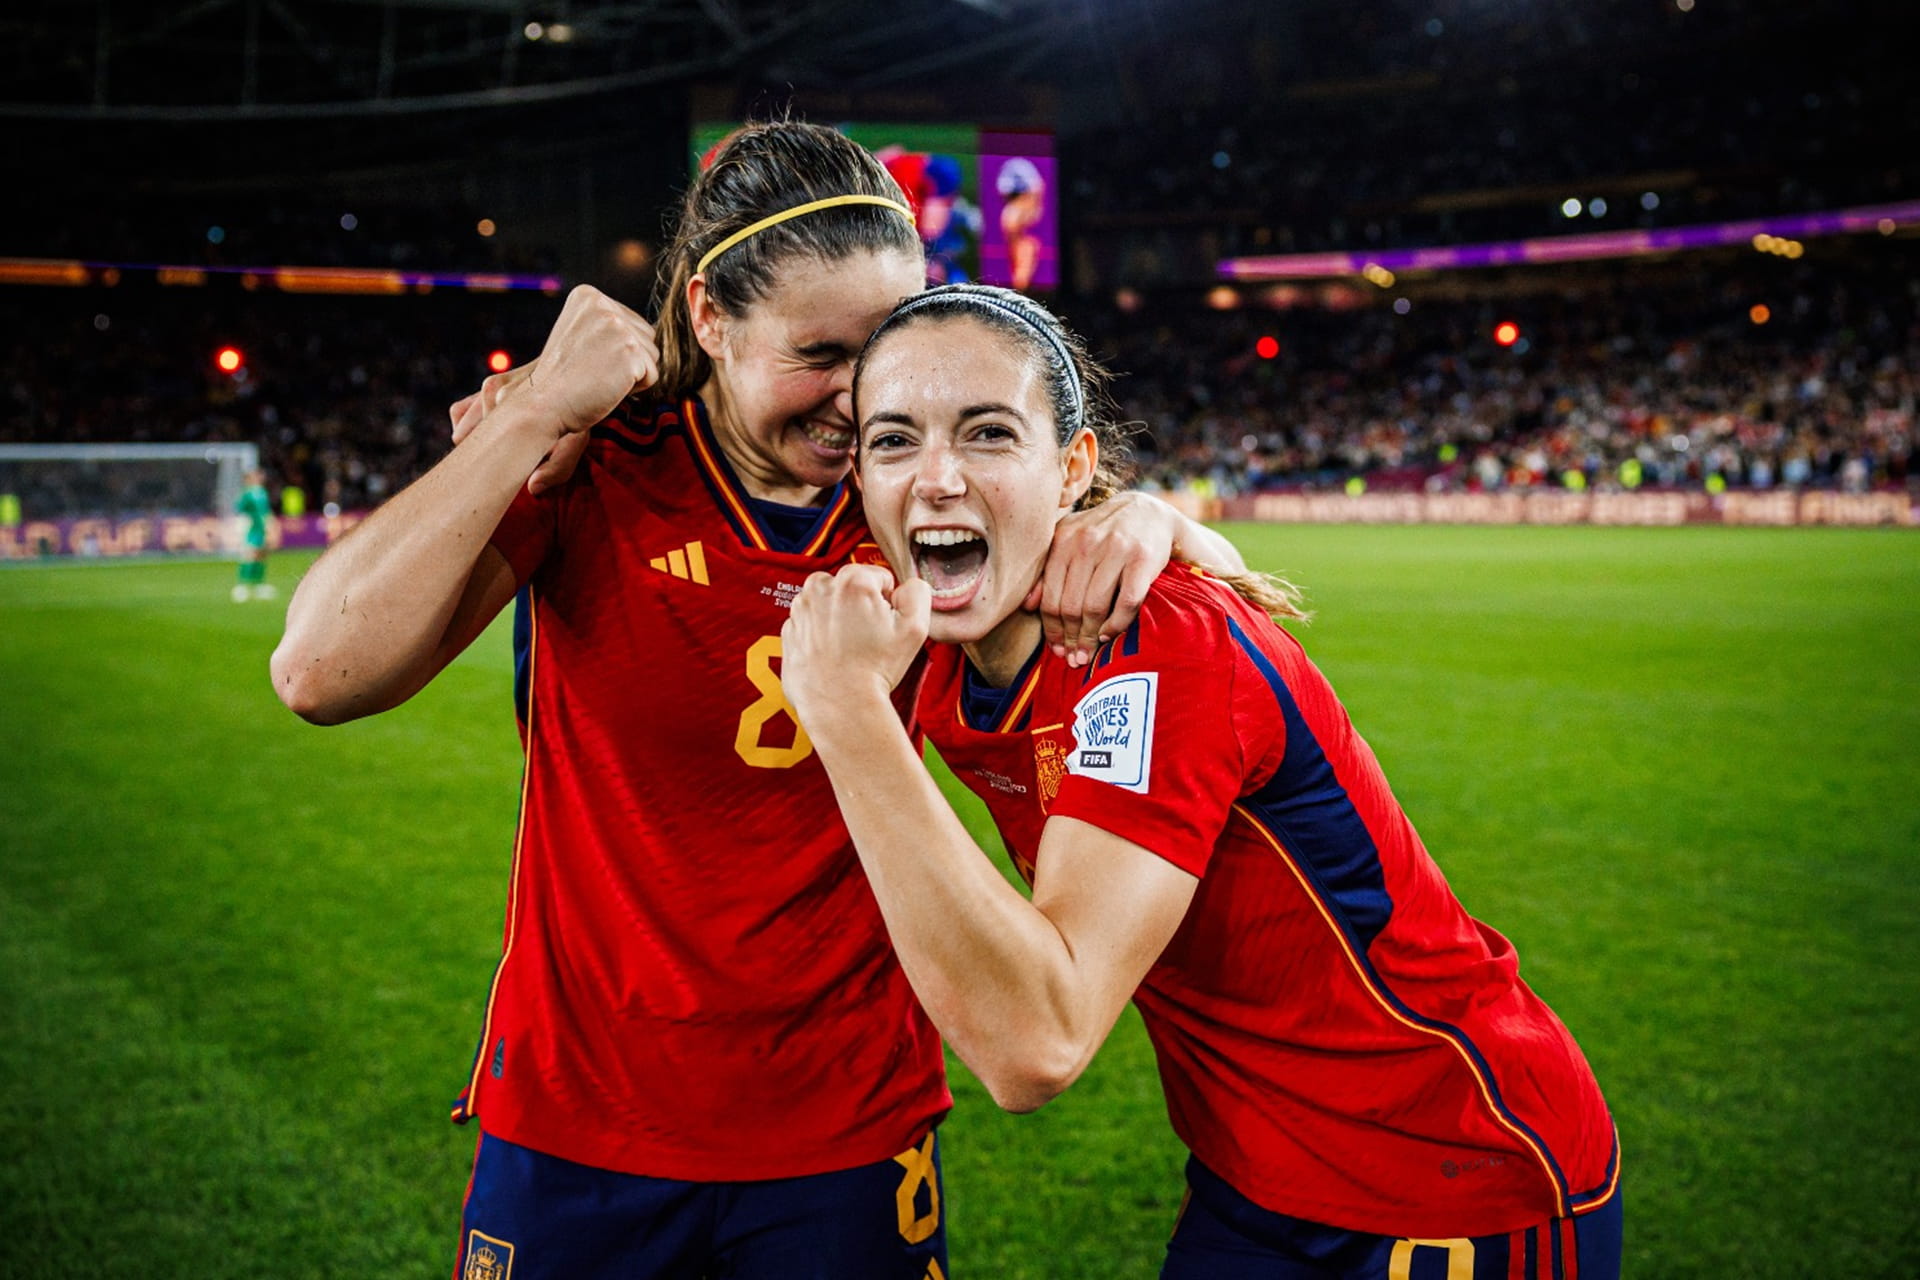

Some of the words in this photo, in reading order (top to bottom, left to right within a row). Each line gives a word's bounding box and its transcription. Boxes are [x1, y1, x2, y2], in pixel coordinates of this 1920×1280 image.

[734, 635, 813, 768] 8
[1083, 693, 1130, 720] FOOTBALL
[1083, 754, 1108, 765] FIFA
